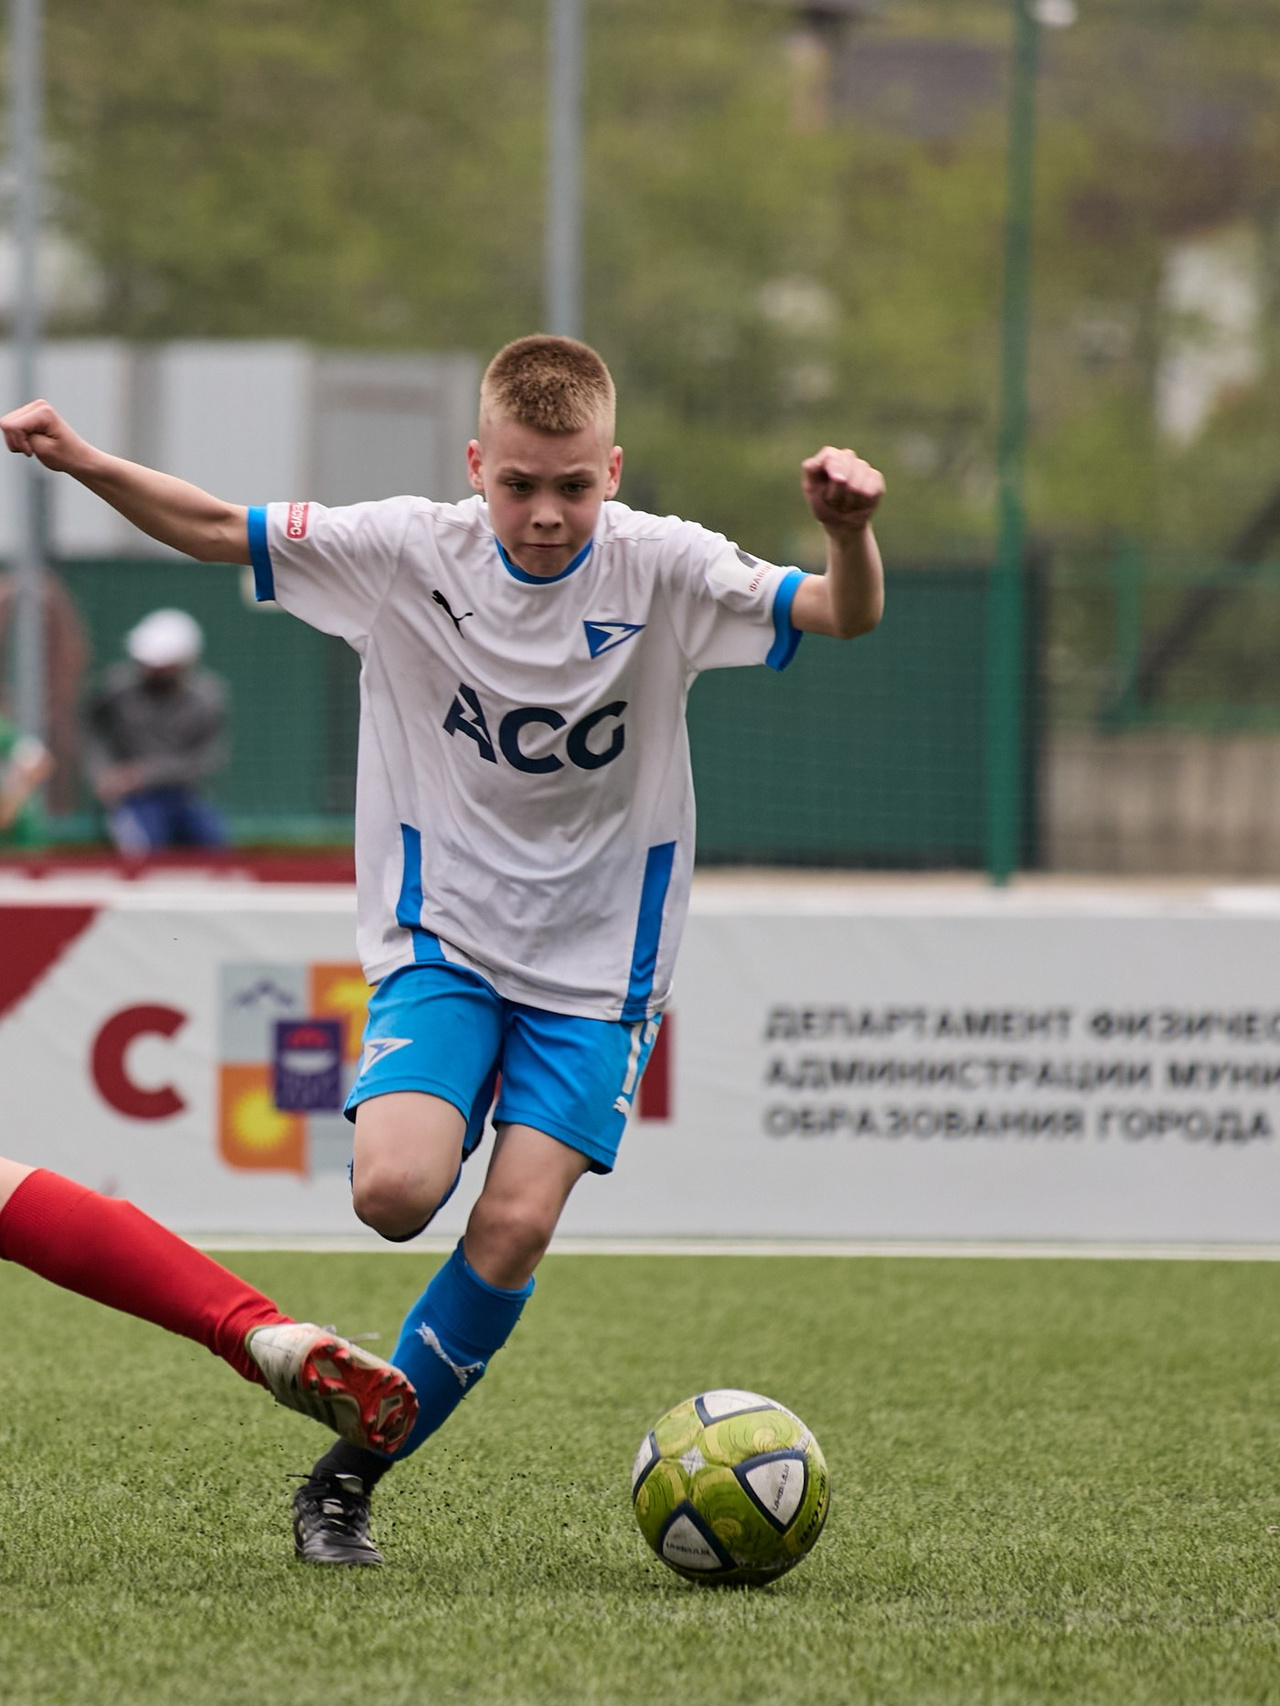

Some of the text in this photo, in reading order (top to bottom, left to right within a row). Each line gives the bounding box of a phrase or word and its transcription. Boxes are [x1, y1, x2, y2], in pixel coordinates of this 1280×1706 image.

[766, 1007, 1071, 1040] ДЕПАРТАМЕНТ
[766, 1058, 1150, 1092] АДМИНИСТРАЦИИ
[766, 1106, 1273, 1146] ОБРАЗОВАНИЯ ГОРОДА
